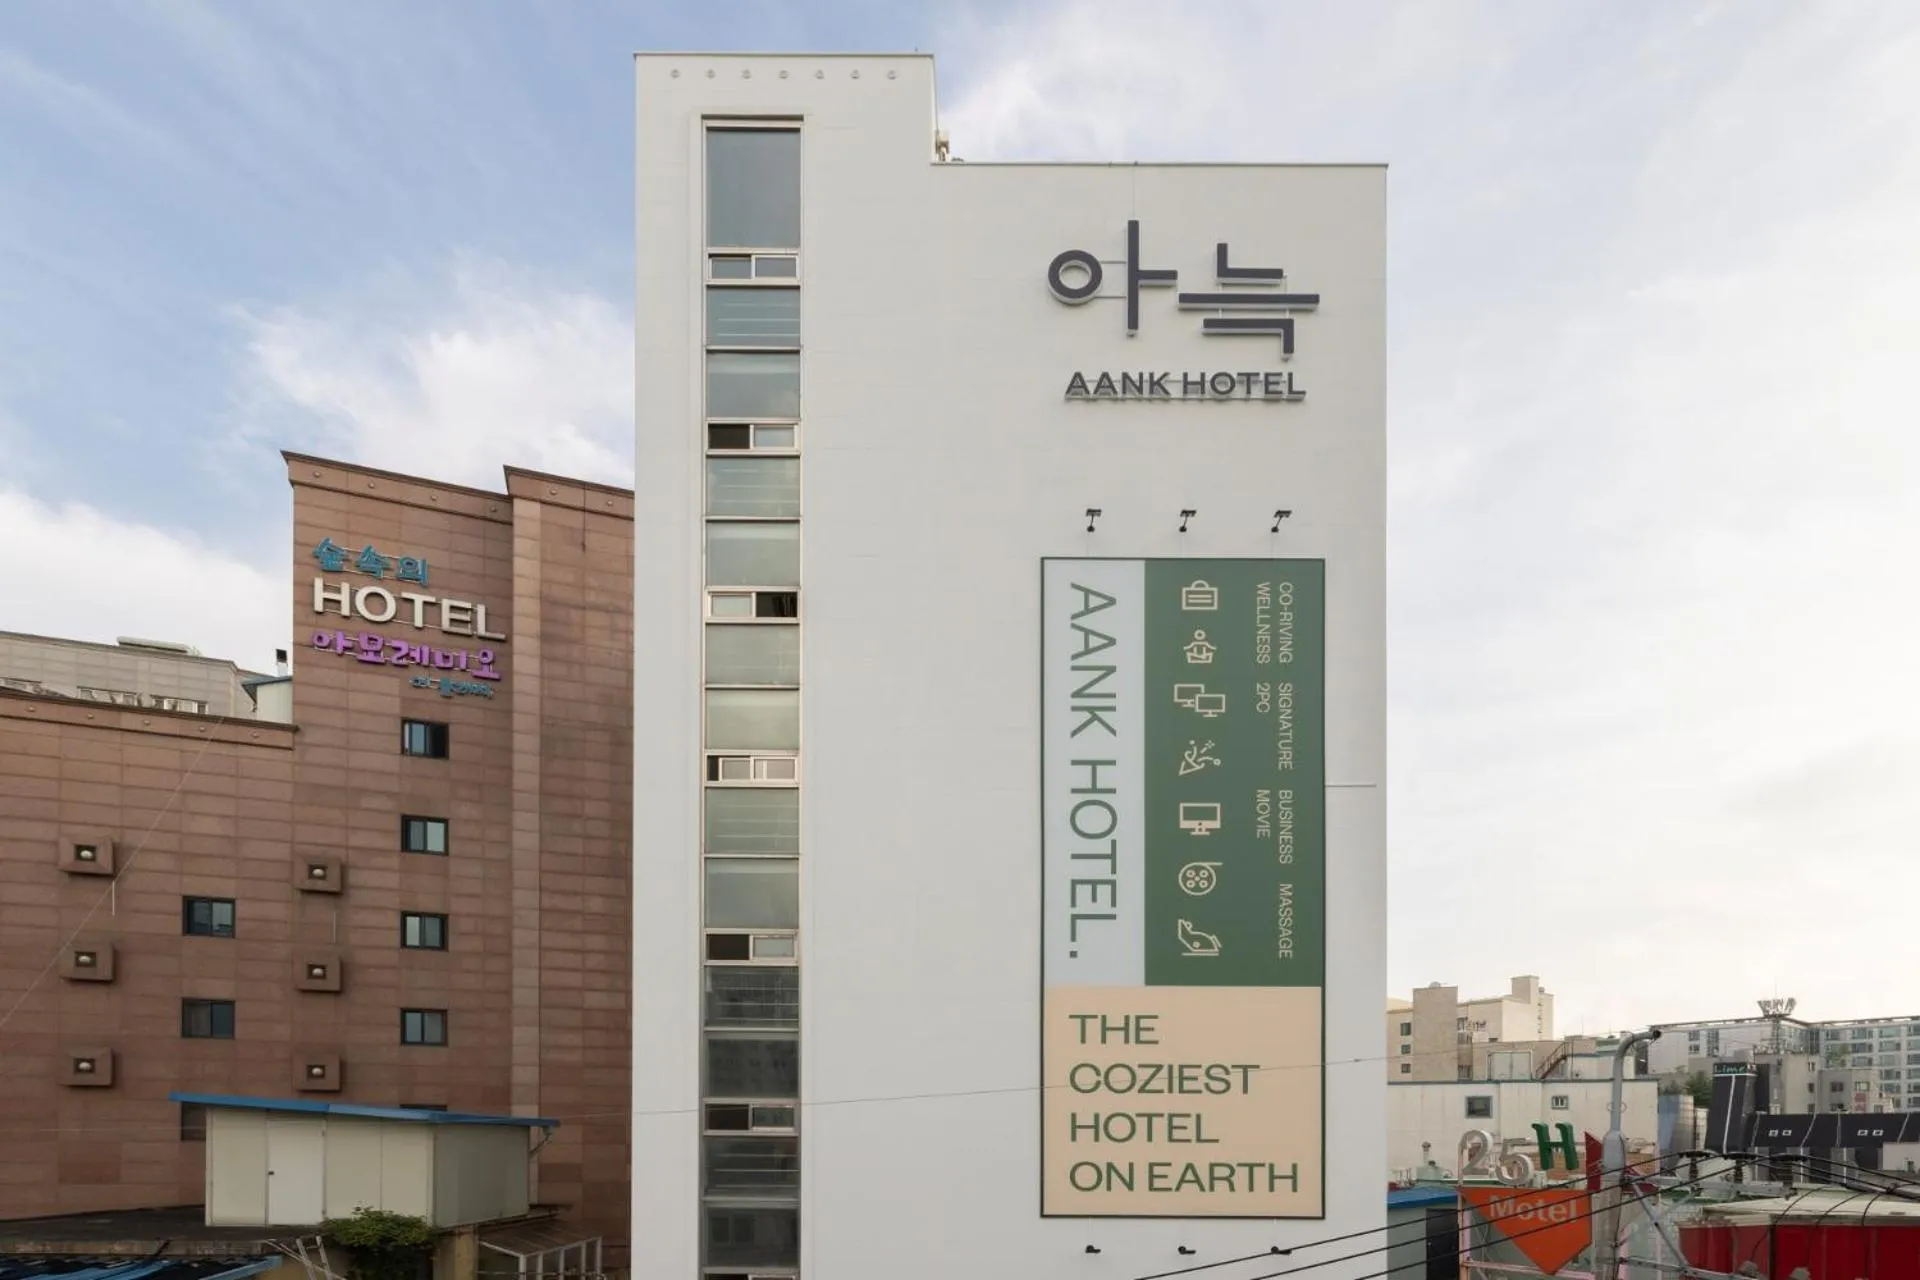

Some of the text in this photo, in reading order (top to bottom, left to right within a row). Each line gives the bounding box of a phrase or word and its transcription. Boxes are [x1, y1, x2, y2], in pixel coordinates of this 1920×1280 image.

[1048, 219, 1320, 361] 아늑
[1065, 371, 1306, 400] AANK HOTEL
[313, 577, 506, 641] HOTEL
[1256, 581, 1272, 839] WELLNESS 2PC MOVIE
[1069, 582, 1118, 958] AANK HOTEL.
[1278, 581, 1294, 960] CO-RIVING SIGNATURE BUSINESS MASSAGE
[1069, 1014, 1160, 1045] THE
[1069, 1063, 1261, 1095] COZIEST
[1070, 1112, 1220, 1143] HOTEL
[1069, 1161, 1299, 1193] ON EARTH
[1489, 1195, 1578, 1223] Motel
